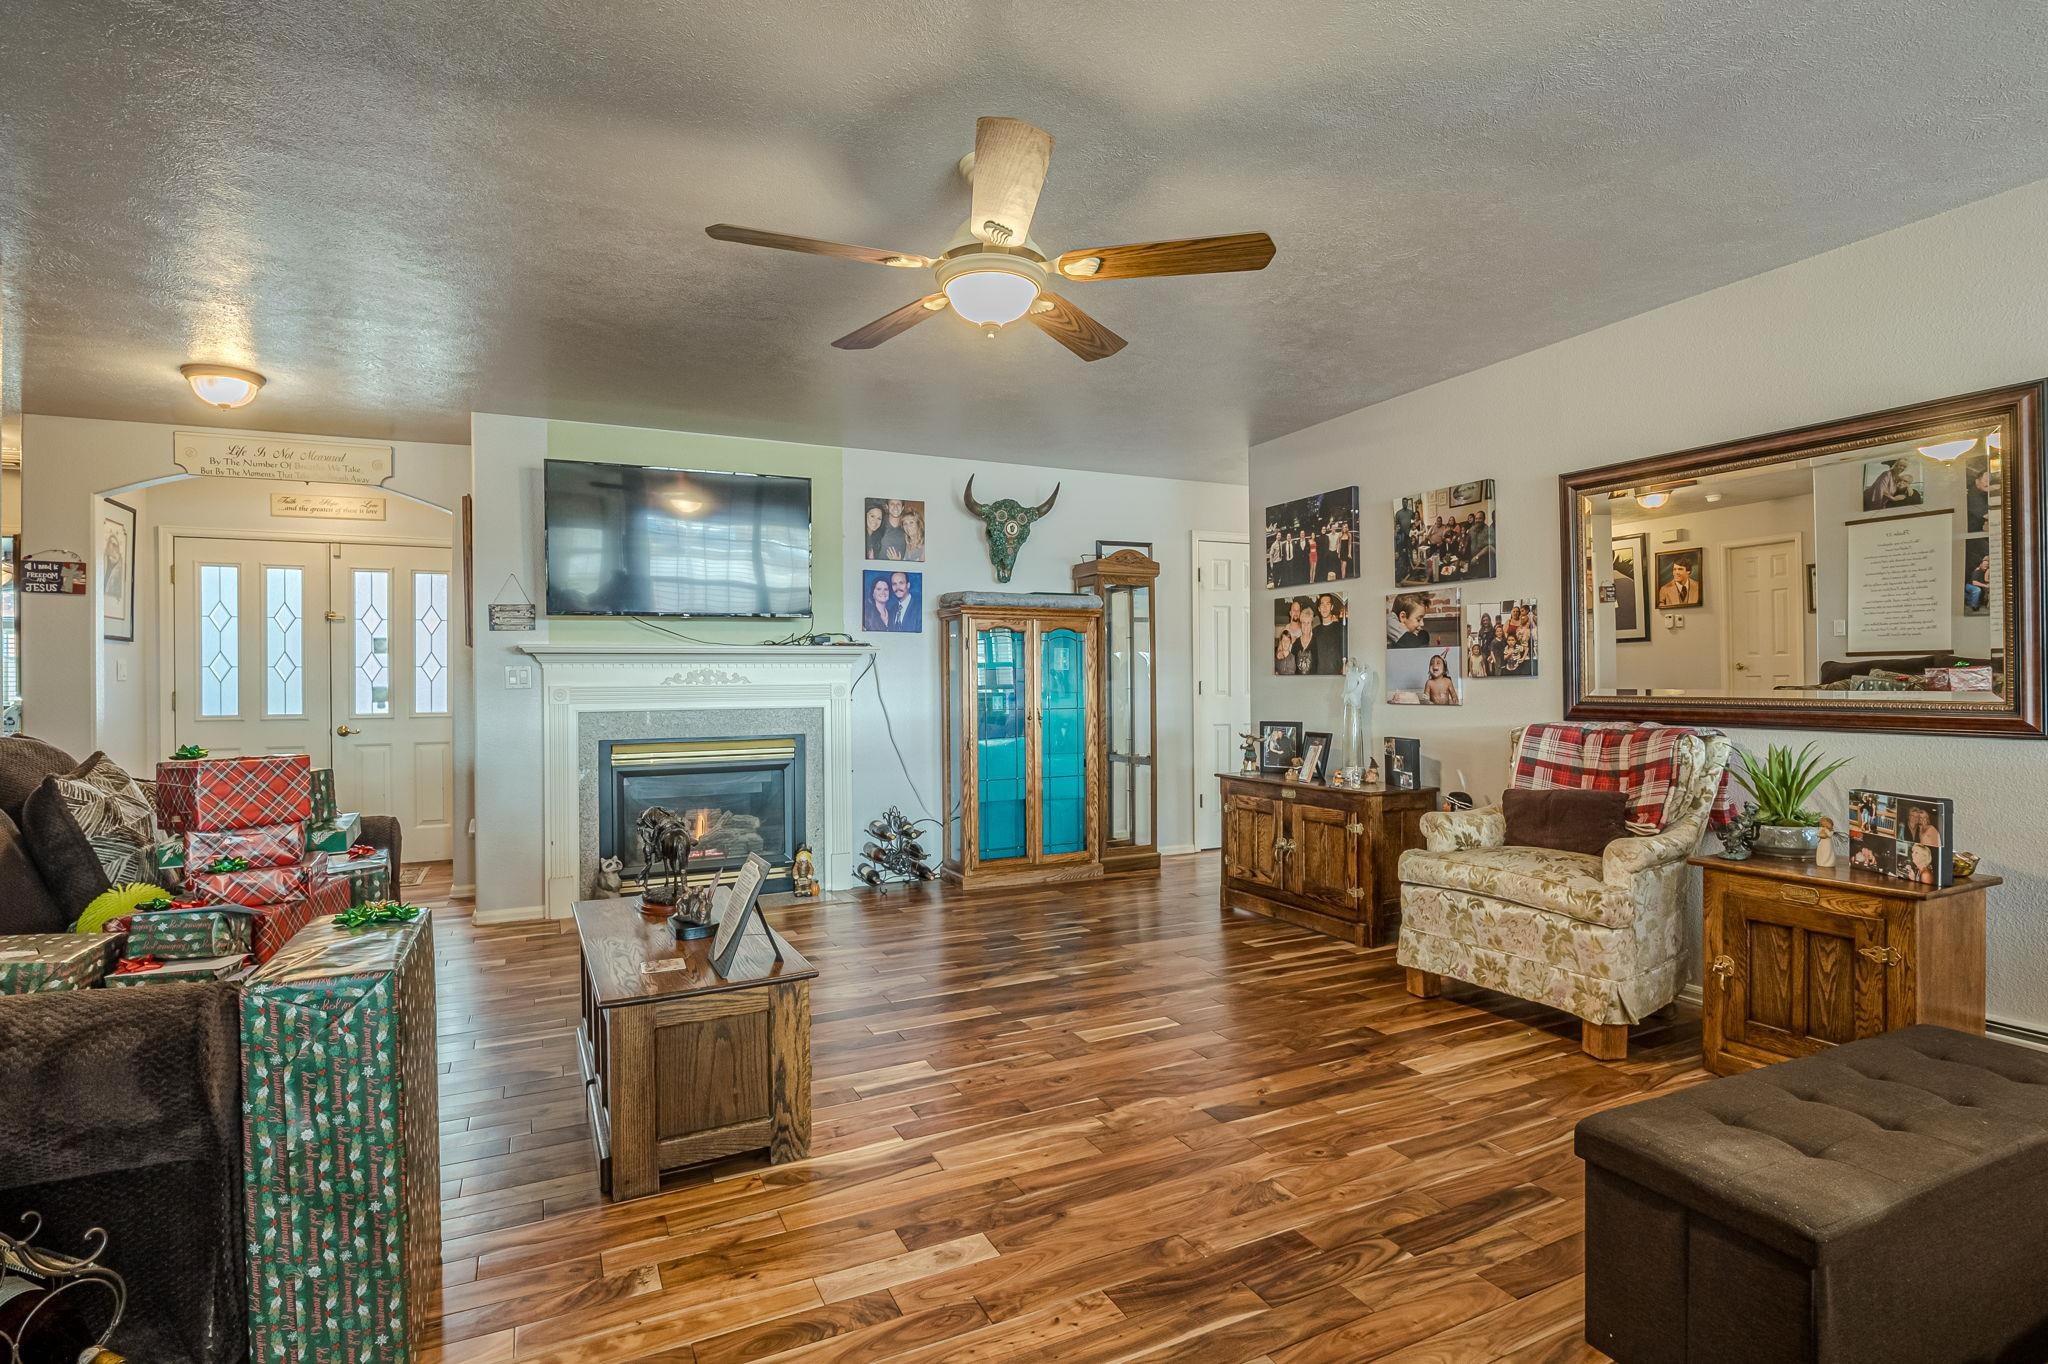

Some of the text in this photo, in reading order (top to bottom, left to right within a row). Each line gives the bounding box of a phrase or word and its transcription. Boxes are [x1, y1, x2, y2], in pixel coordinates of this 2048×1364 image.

[228, 445, 347, 462] Life Is Not Measured
[209, 457, 222, 467] By
[224, 457, 241, 467] The
[243, 459, 278, 469] Number
[280, 461, 292, 470] Of
[344, 464, 362, 473] Take
[200, 466, 214, 476] But
[216, 467, 225, 476] By
[227, 468, 241, 476] The
[243, 469, 276, 478] Moments
[278, 470, 293, 479] That
[26, 571, 59, 580] FREEDOM
[25, 583, 58, 592] JESUS
